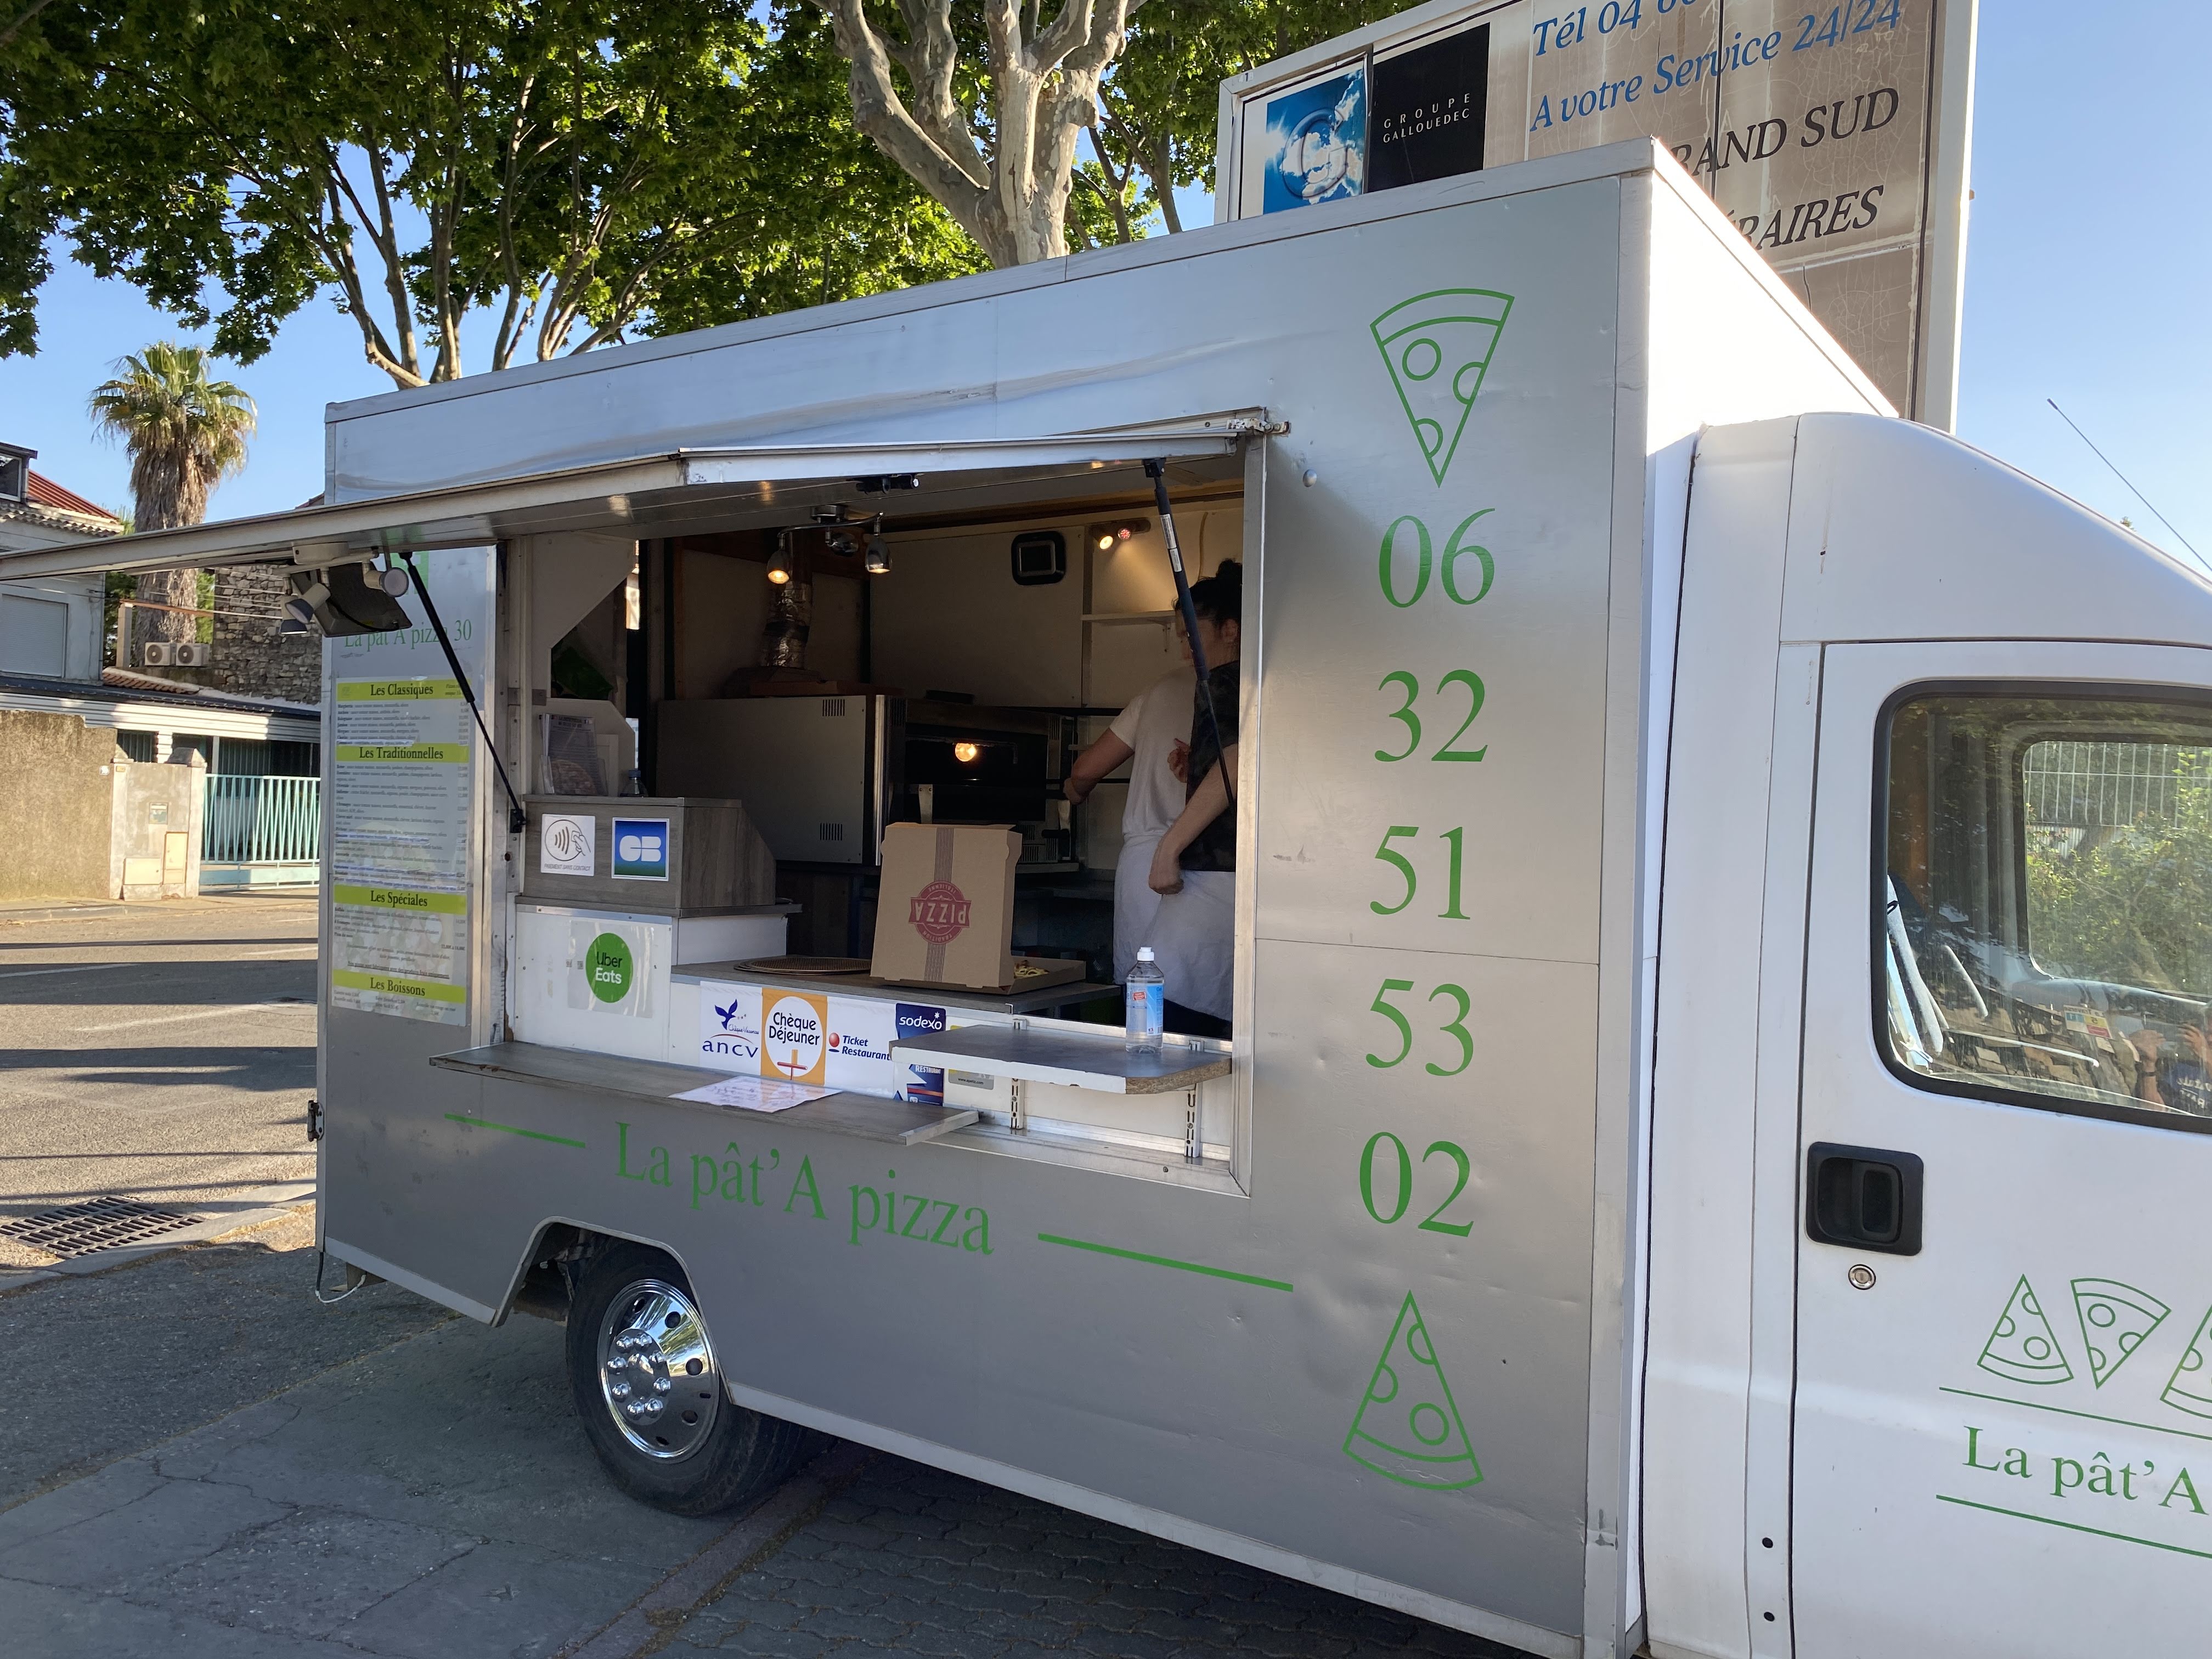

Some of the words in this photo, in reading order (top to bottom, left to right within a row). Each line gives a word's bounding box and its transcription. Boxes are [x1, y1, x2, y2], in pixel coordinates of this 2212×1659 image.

[1533, 7, 1586, 56] Tél
[1598, 0, 1641, 34] 04
[1653, 31, 1781, 94] Service
[1792, 0, 1900, 52] 24/24
[1384, 93, 1471, 128] GROUPE
[1801, 88, 1899, 147] SUD
[1383, 108, 1470, 143] GALLOUEDEC
[1379, 509, 1494, 607] 06
[454, 619, 472, 641] 30
[370, 684, 385, 696] Les
[387, 682, 433, 699] Classiques
[1375, 670, 1487, 761] 32
[359, 746, 374, 759] Les
[376, 747, 444, 761] Traditionnelles
[1370, 826, 1470, 920] 51
[370, 890, 385, 902] Les
[387, 891, 428, 908] Spéciales
[915, 901, 967, 924] PIZZA
[596, 951, 623, 968] Uber
[370, 978, 385, 990] Les
[387, 980, 426, 996] Boissons
[595, 967, 622, 985] Eats
[773, 1012, 816, 1031] Chèque
[899, 1014, 943, 1030] sodexo
[1366, 979, 1472, 1076] 53
[769, 1025, 820, 1046] Déjeuner
[842, 1035, 868, 1047] Ticket
[702, 1040, 758, 1058] ancv
[842, 1046, 891, 1061] Restaurant
[915, 1065, 941, 1074] RESTAURANT
[615, 1121, 673, 1187] La
[849, 1170, 992, 1255] pizza
[1360, 1132, 1472, 1237] 02
[1963, 1425, 2032, 1479] La
